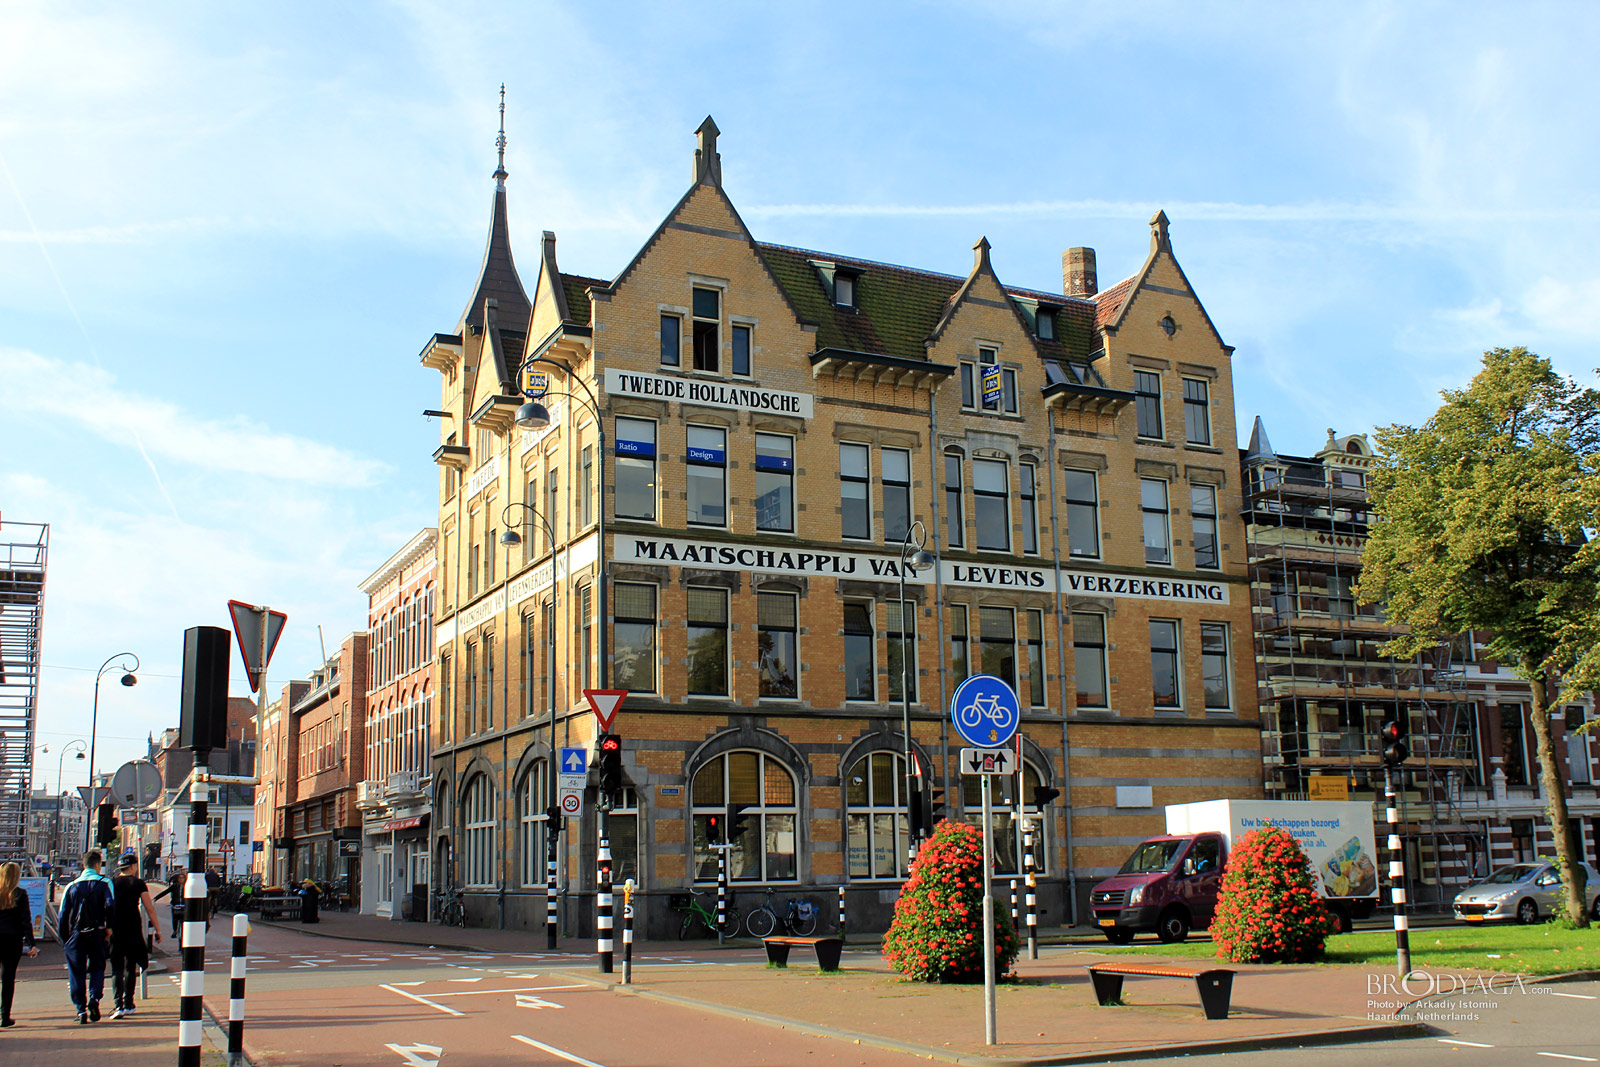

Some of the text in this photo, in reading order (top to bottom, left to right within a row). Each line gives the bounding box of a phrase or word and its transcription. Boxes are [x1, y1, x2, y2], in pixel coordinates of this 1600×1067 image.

[618, 374, 801, 413] TWEEDE HOLLANDSCHE
[618, 442, 638, 451] Ratio
[690, 450, 714, 460] Design
[472, 462, 496, 493] TWEEDE
[509, 556, 567, 602] LEVENSVERZEKEING
[634, 540, 1223, 601] MAATSCHAPPIJ VAN LEVENS VERZEKERING
[1241, 818, 1340, 829] Uw bdschappen bezorgd
[1303, 838, 1314, 847] via
